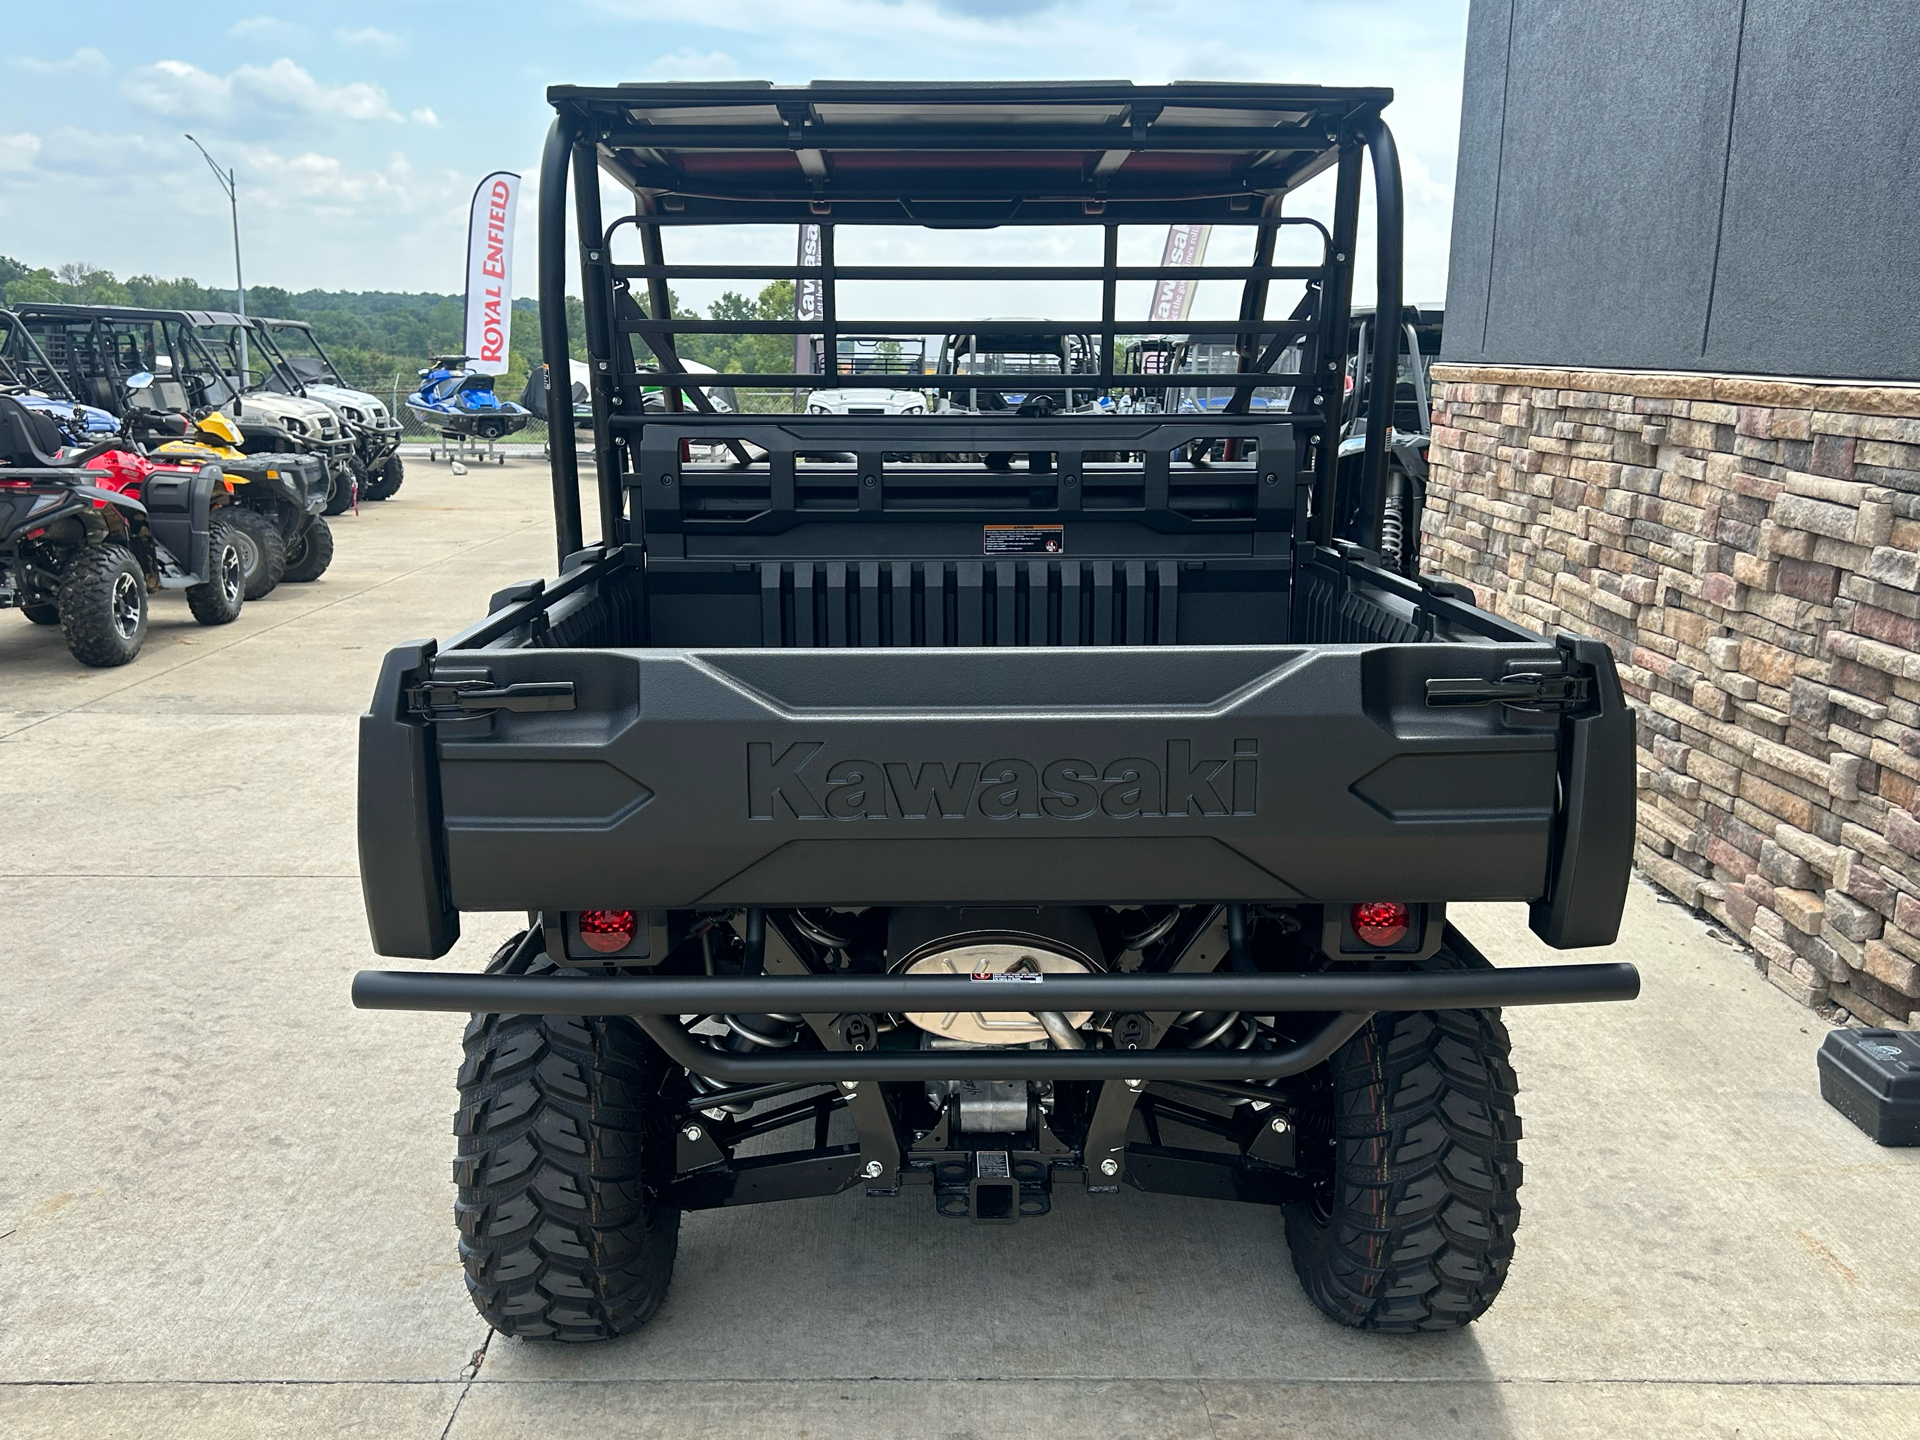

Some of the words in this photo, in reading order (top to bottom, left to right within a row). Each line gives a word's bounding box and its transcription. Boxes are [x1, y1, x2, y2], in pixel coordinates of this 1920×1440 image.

[482, 180, 510, 280] ENFIELD
[797, 224, 819, 321] Kawasa
[1173, 295, 1183, 310] the
[481, 286, 504, 362] ROYAL
[746, 738, 1259, 821] Kawasaki
